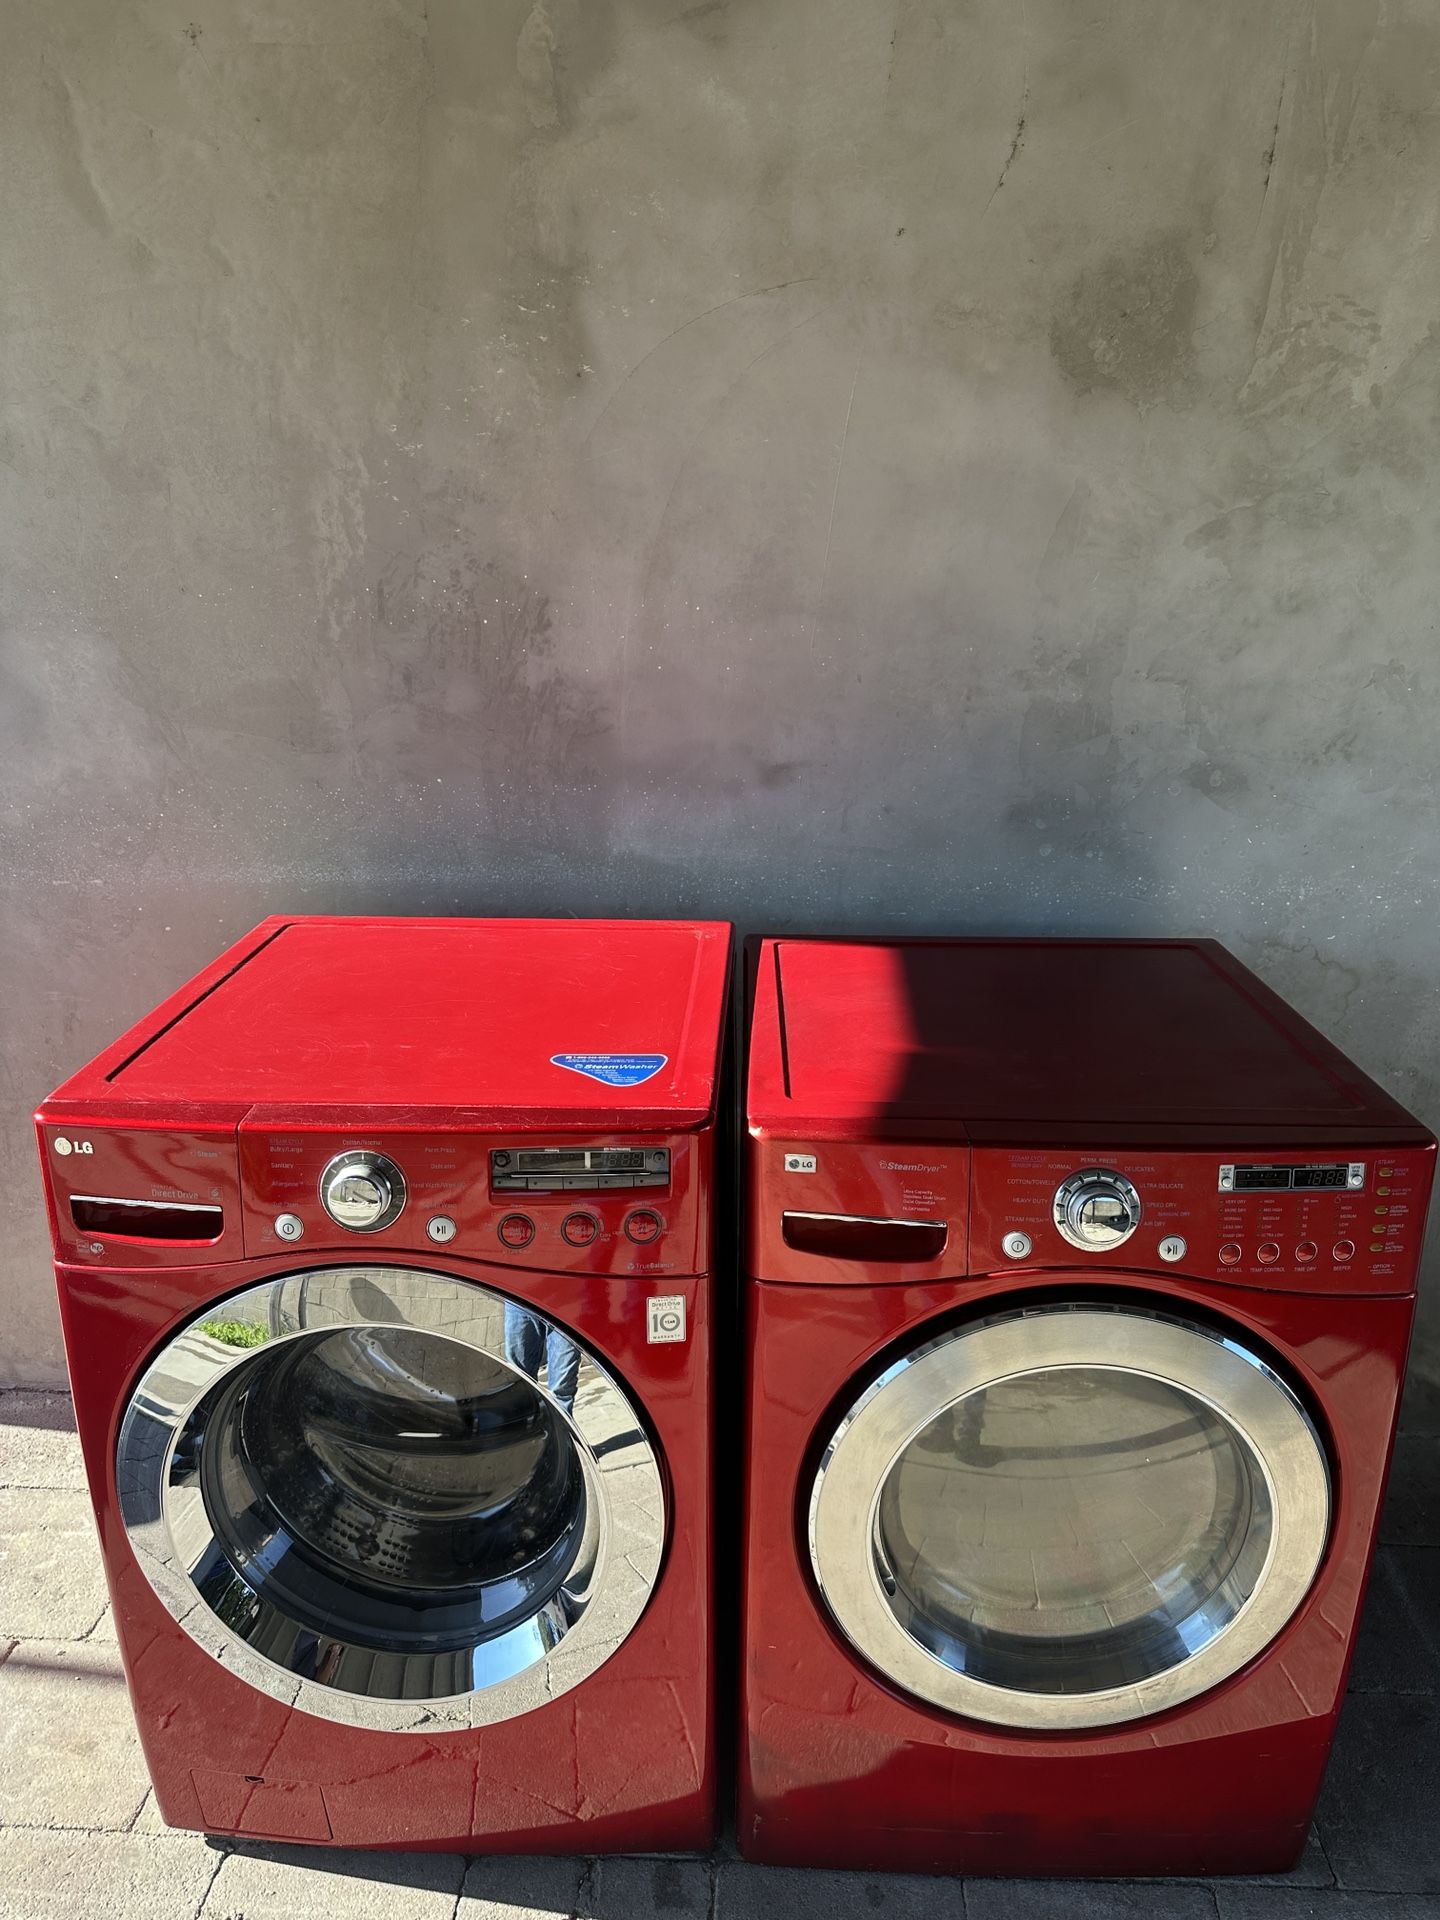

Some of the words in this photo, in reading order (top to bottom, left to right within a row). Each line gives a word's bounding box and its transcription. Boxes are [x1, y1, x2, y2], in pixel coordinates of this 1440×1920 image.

[73, 1141, 94, 1154] LG
[1007, 1178, 1057, 1186] COTTON/TOWELS
[152, 1188, 176, 1199] Direct
[177, 1190, 199, 1200] Drive
[653, 1312, 681, 1332] 10
